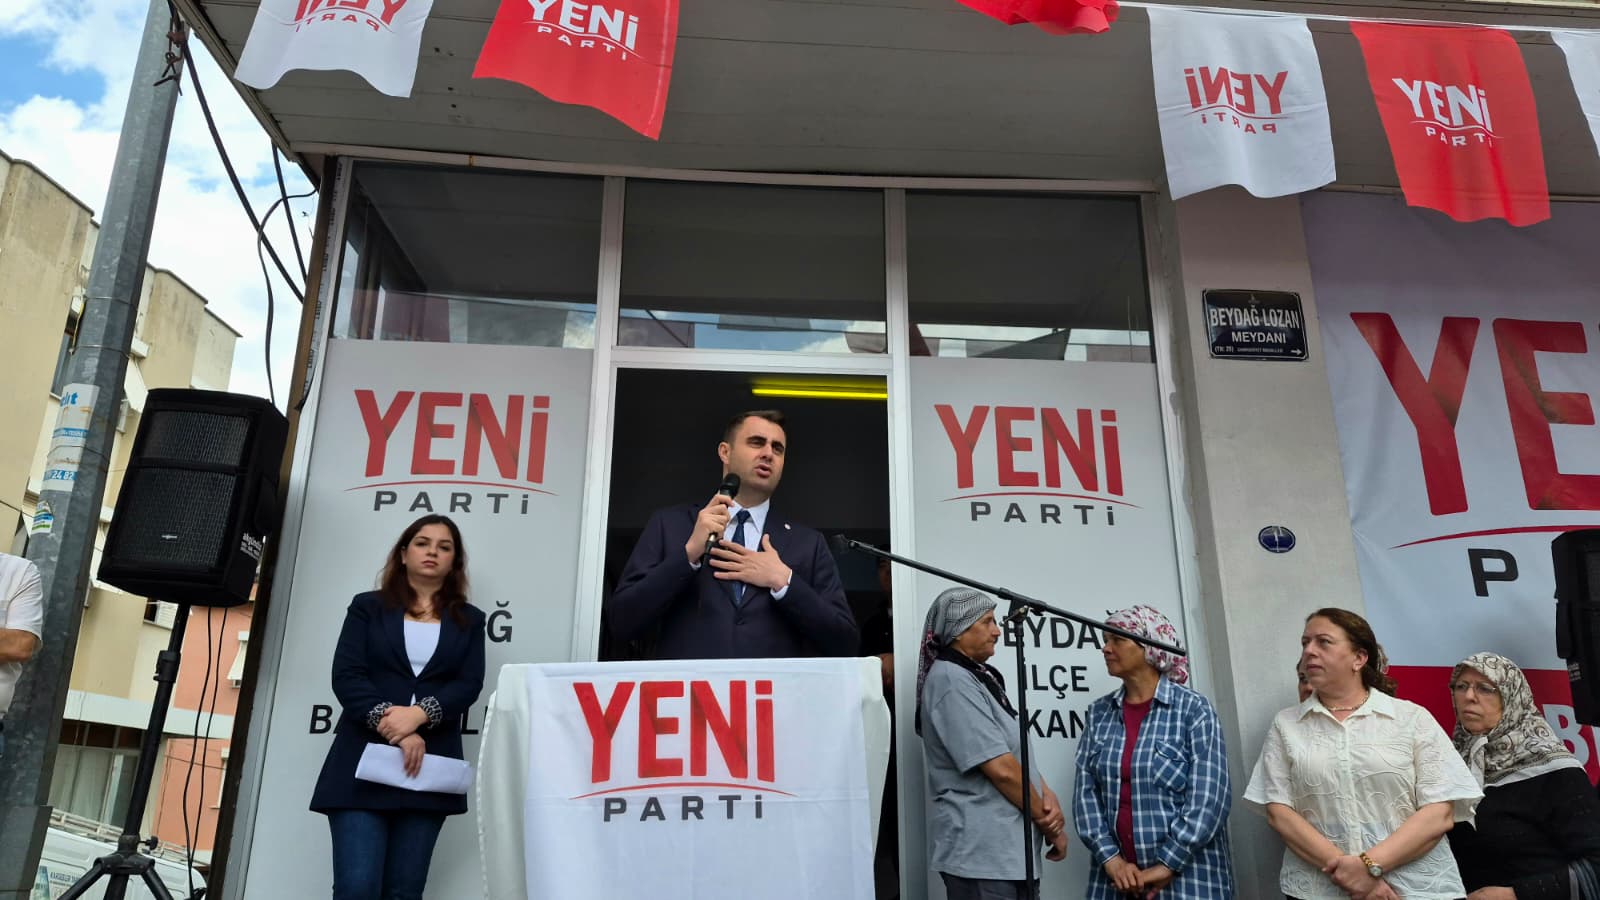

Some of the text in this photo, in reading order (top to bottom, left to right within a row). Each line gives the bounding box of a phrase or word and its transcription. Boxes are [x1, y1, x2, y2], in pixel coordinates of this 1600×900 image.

[1210, 304, 1300, 329] BEYDAĞ LOZAN
[1231, 331, 1287, 344] MEYDANI
[1350, 312, 1600, 516] YE
[1003, 610, 1116, 650] EYDA
